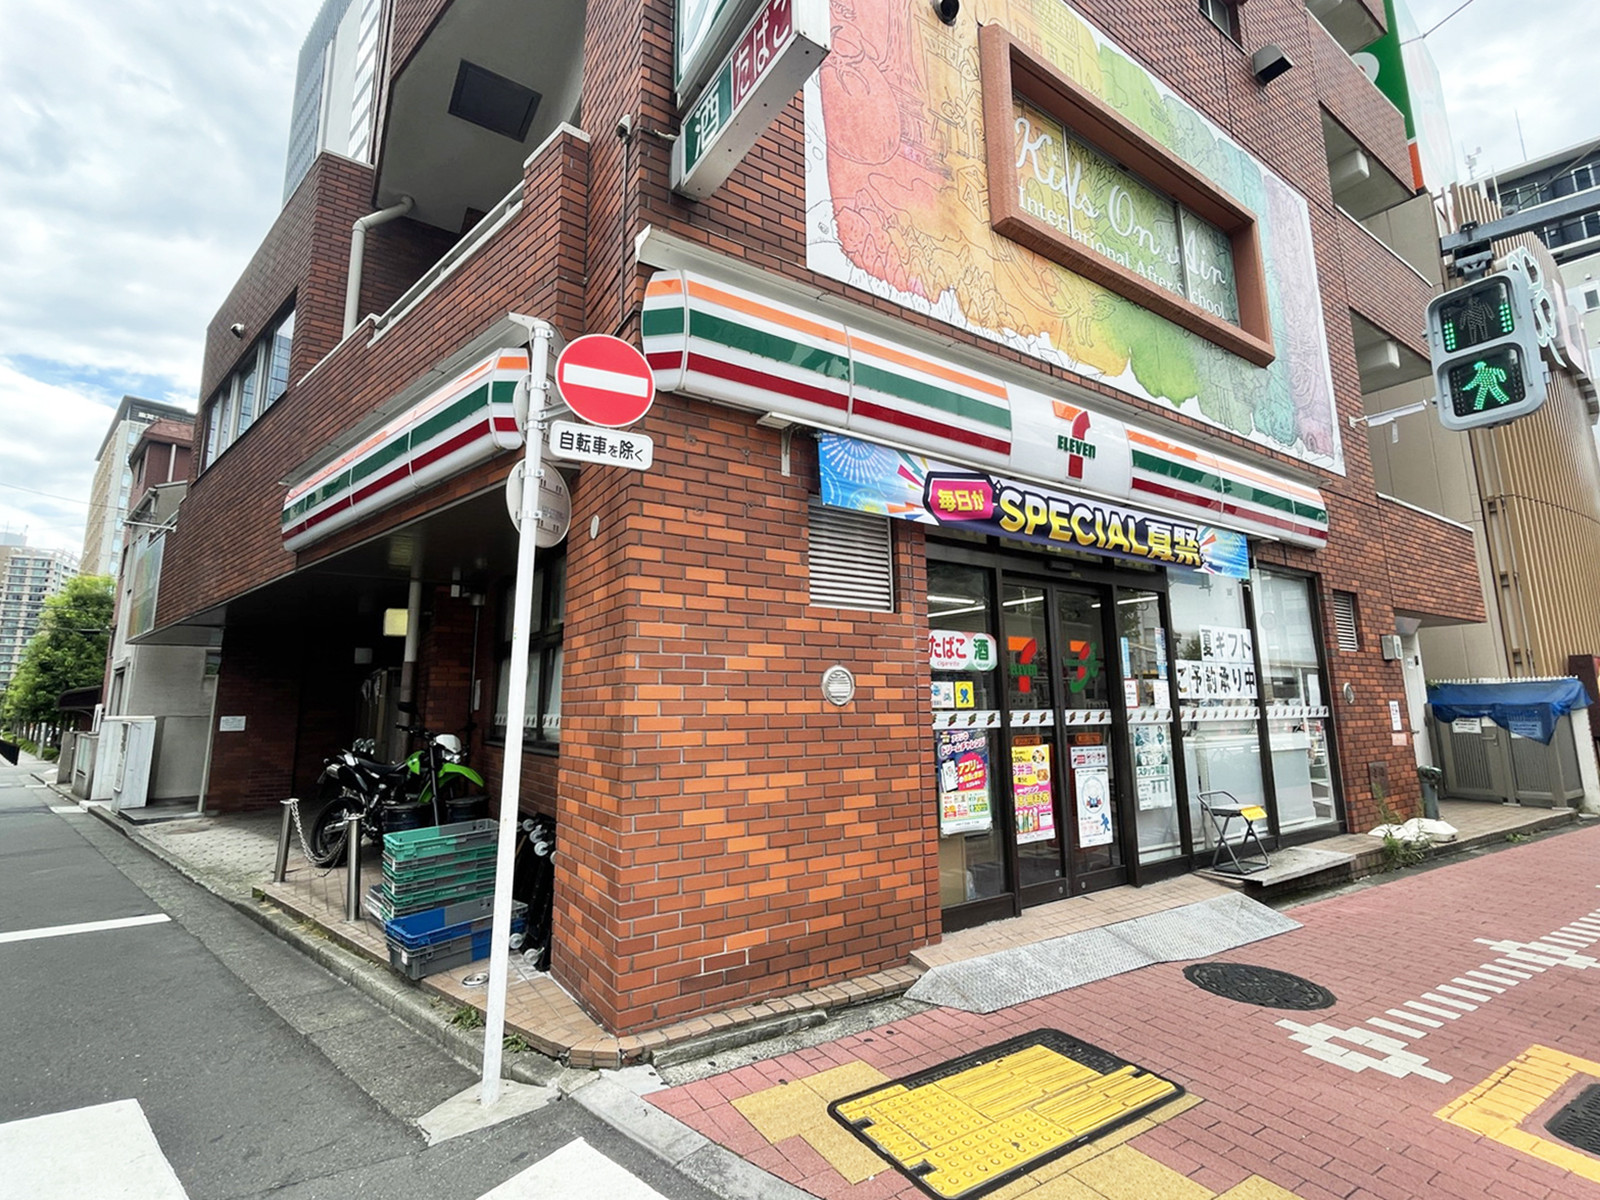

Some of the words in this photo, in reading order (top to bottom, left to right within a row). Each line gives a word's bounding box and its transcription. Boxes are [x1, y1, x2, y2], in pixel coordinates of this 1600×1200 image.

[694, 80, 721, 161] 酒
[734, 0, 790, 105] たばこ
[1015, 117, 1100, 218] Kids
[1108, 184, 1161, 255] On
[1136, 261, 1174, 295] After
[1177, 283, 1227, 320] School
[559, 430, 644, 463] 自転車を除く
[938, 489, 985, 513] 毎日が
[929, 635, 967, 659] たばこ
[973, 638, 989, 660] 酒
[1201, 628, 1251, 659] 夏ギフト
